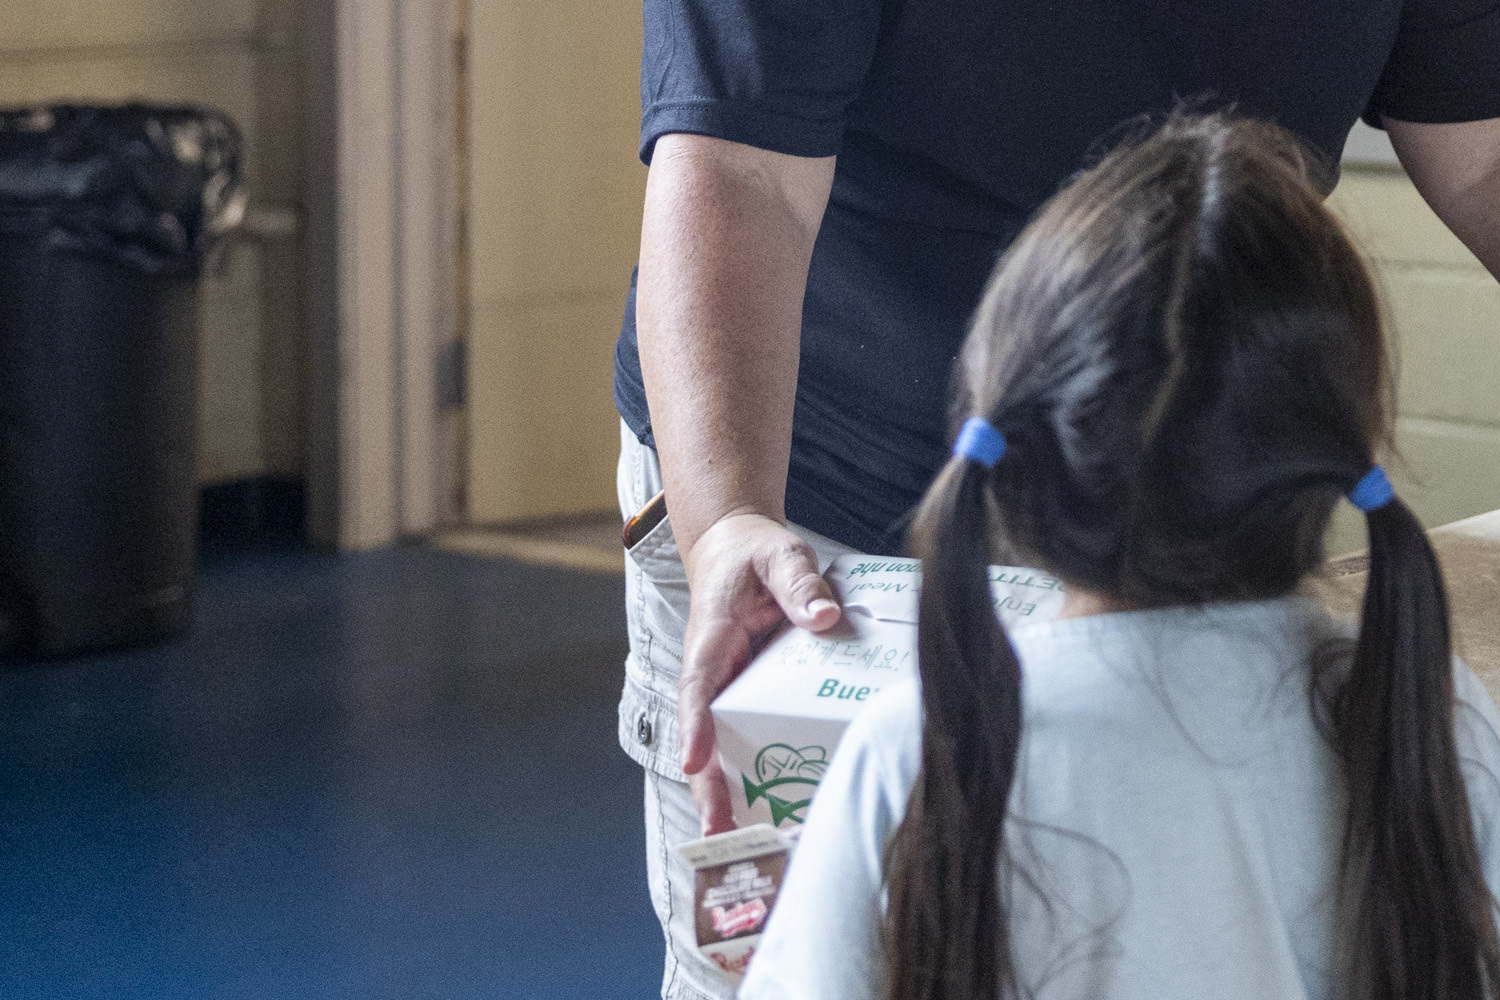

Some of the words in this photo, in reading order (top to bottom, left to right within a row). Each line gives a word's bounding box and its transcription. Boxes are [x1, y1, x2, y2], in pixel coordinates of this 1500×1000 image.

[845, 562, 884, 579] nhé
[847, 582, 908, 594] Meal
[834, 644, 910, 672] 드세요!
[817, 678, 880, 701] Bue
